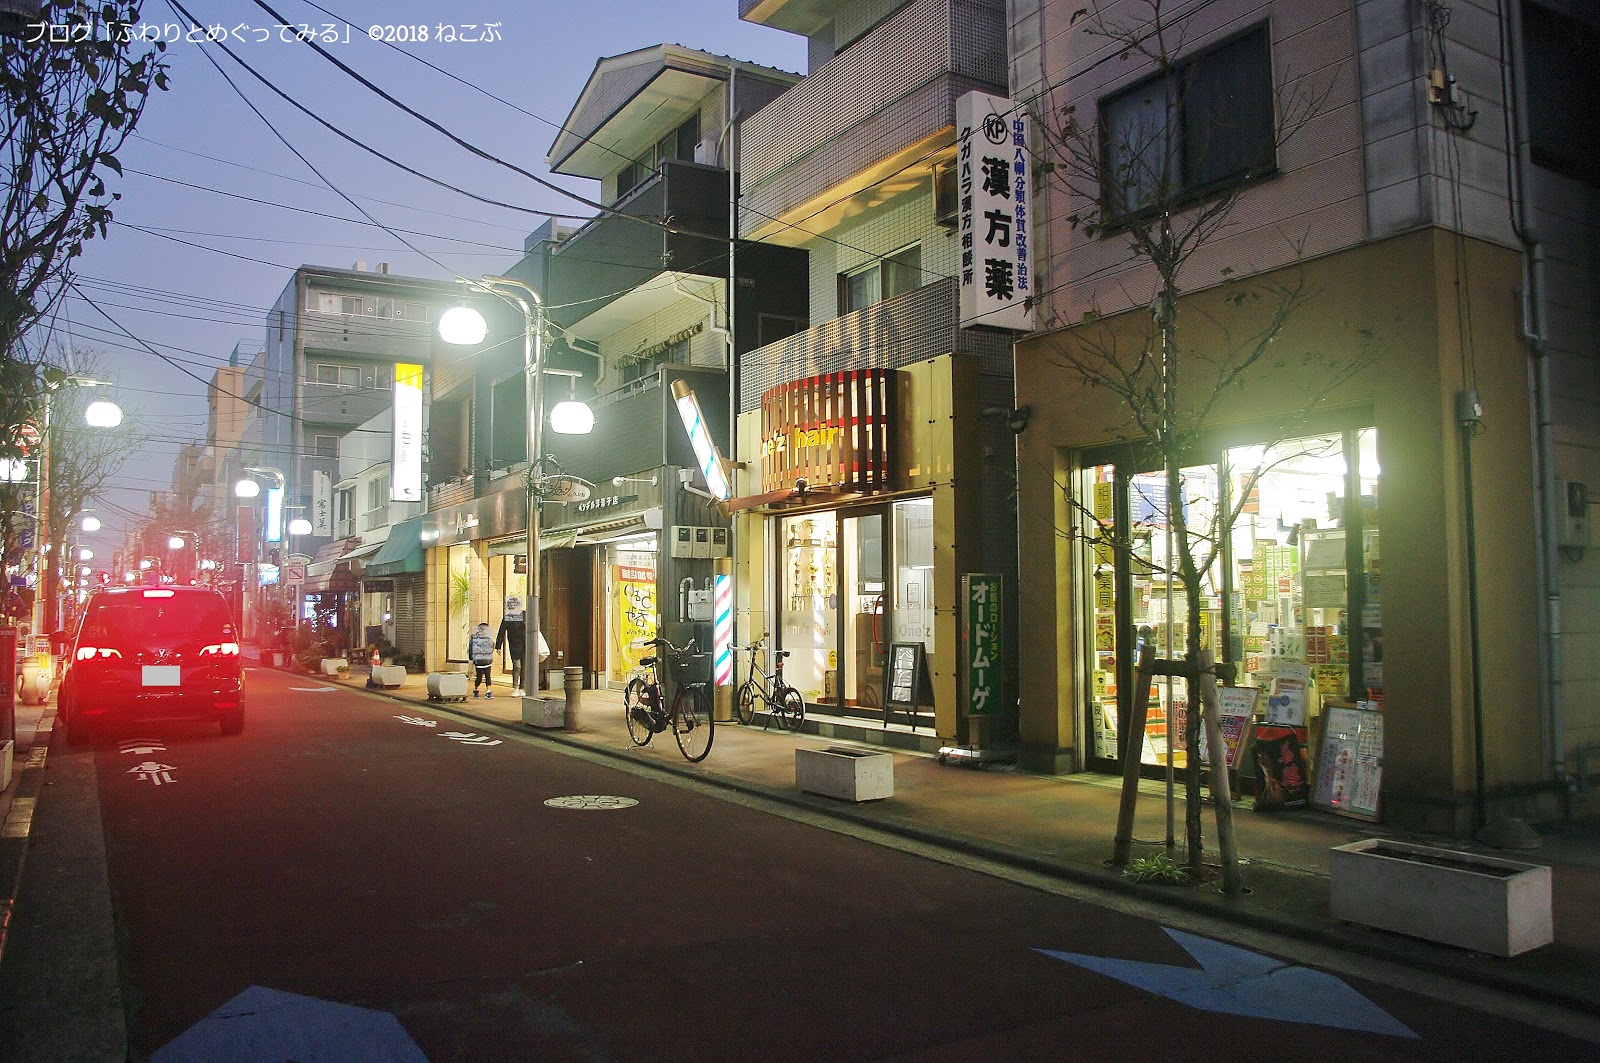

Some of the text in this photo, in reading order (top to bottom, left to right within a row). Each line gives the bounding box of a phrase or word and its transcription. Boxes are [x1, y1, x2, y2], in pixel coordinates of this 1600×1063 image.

[986, 118, 1005, 139] KP
[960, 126, 974, 287] クガハラ漢方相談所
[981, 155, 1014, 301] 漢方薬
[760, 420, 839, 458] ne'z hair
[1097, 485, 1110, 519] 相談
[1098, 572, 1111, 608] 薬局
[899, 624, 931, 638] One'z
[971, 582, 990, 710] オードムーゲ
